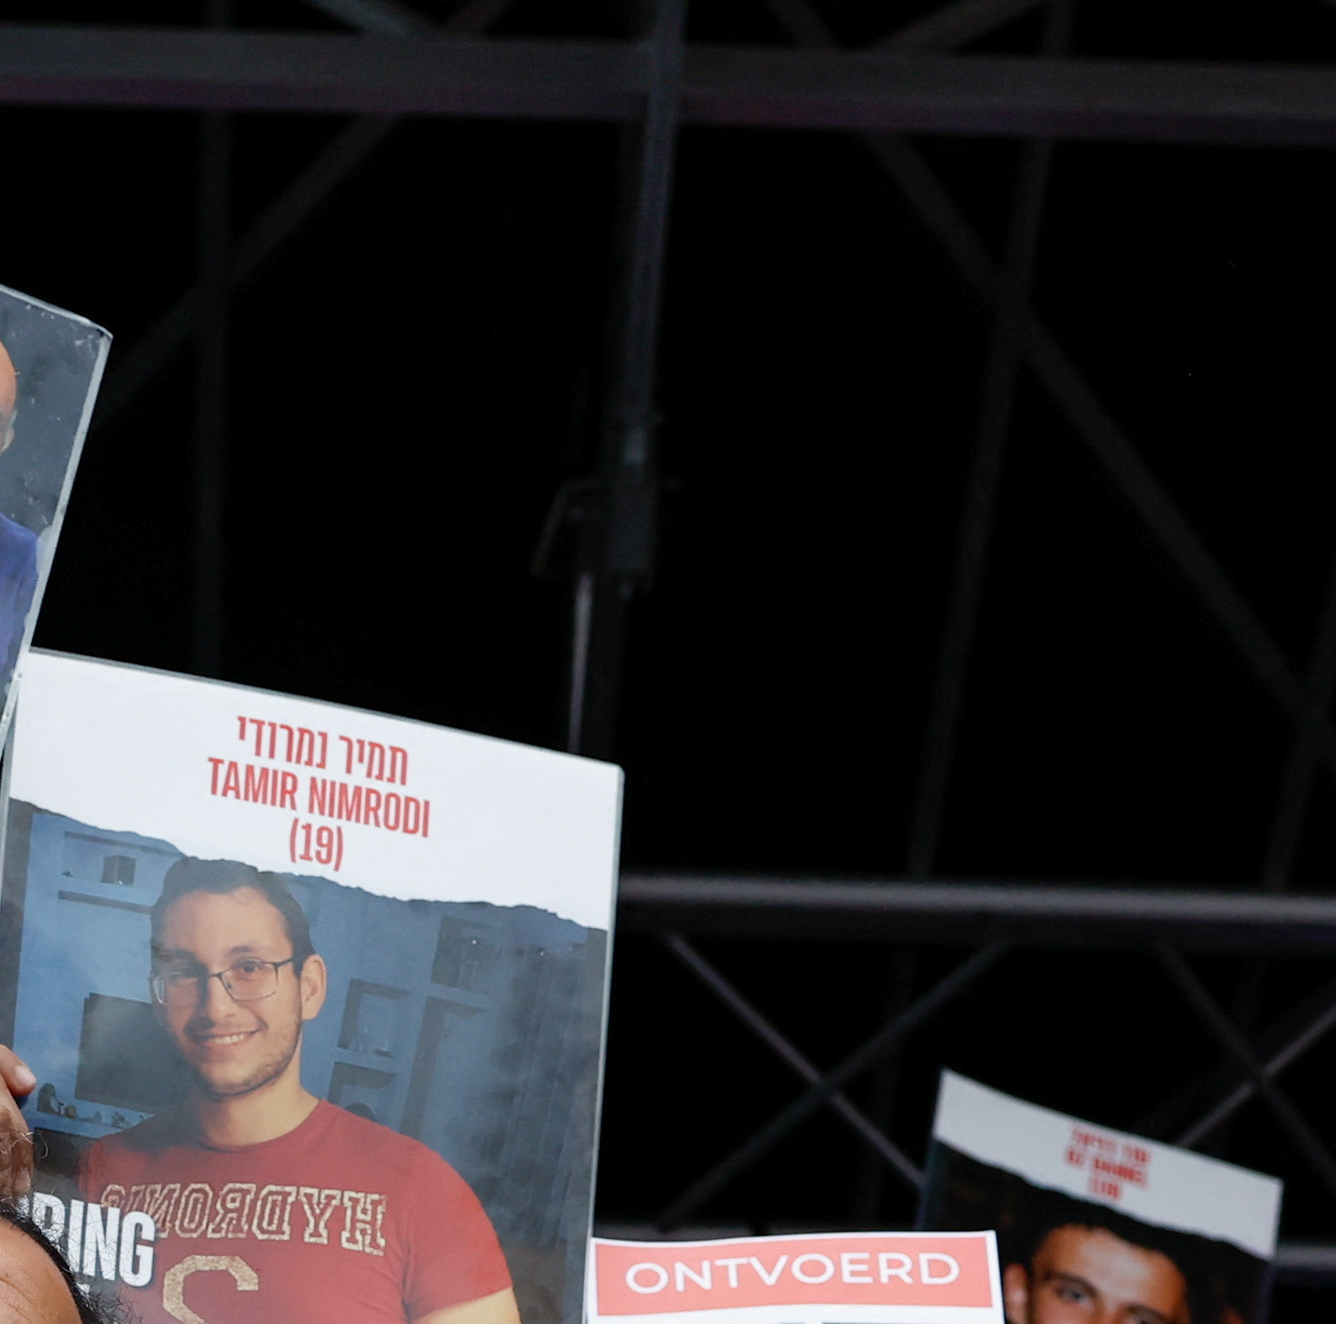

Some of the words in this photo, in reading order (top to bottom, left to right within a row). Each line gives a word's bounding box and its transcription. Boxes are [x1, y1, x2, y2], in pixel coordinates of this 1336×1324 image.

[237, 715, 328, 770] נמרודי
[338, 735, 409, 786] תמיר
[207, 756, 298, 811] TAMIR
[307, 776, 431, 839] NIMRODI
[289, 817, 344, 872] (19)
[624, 1251, 960, 1295] ONTVOERD
